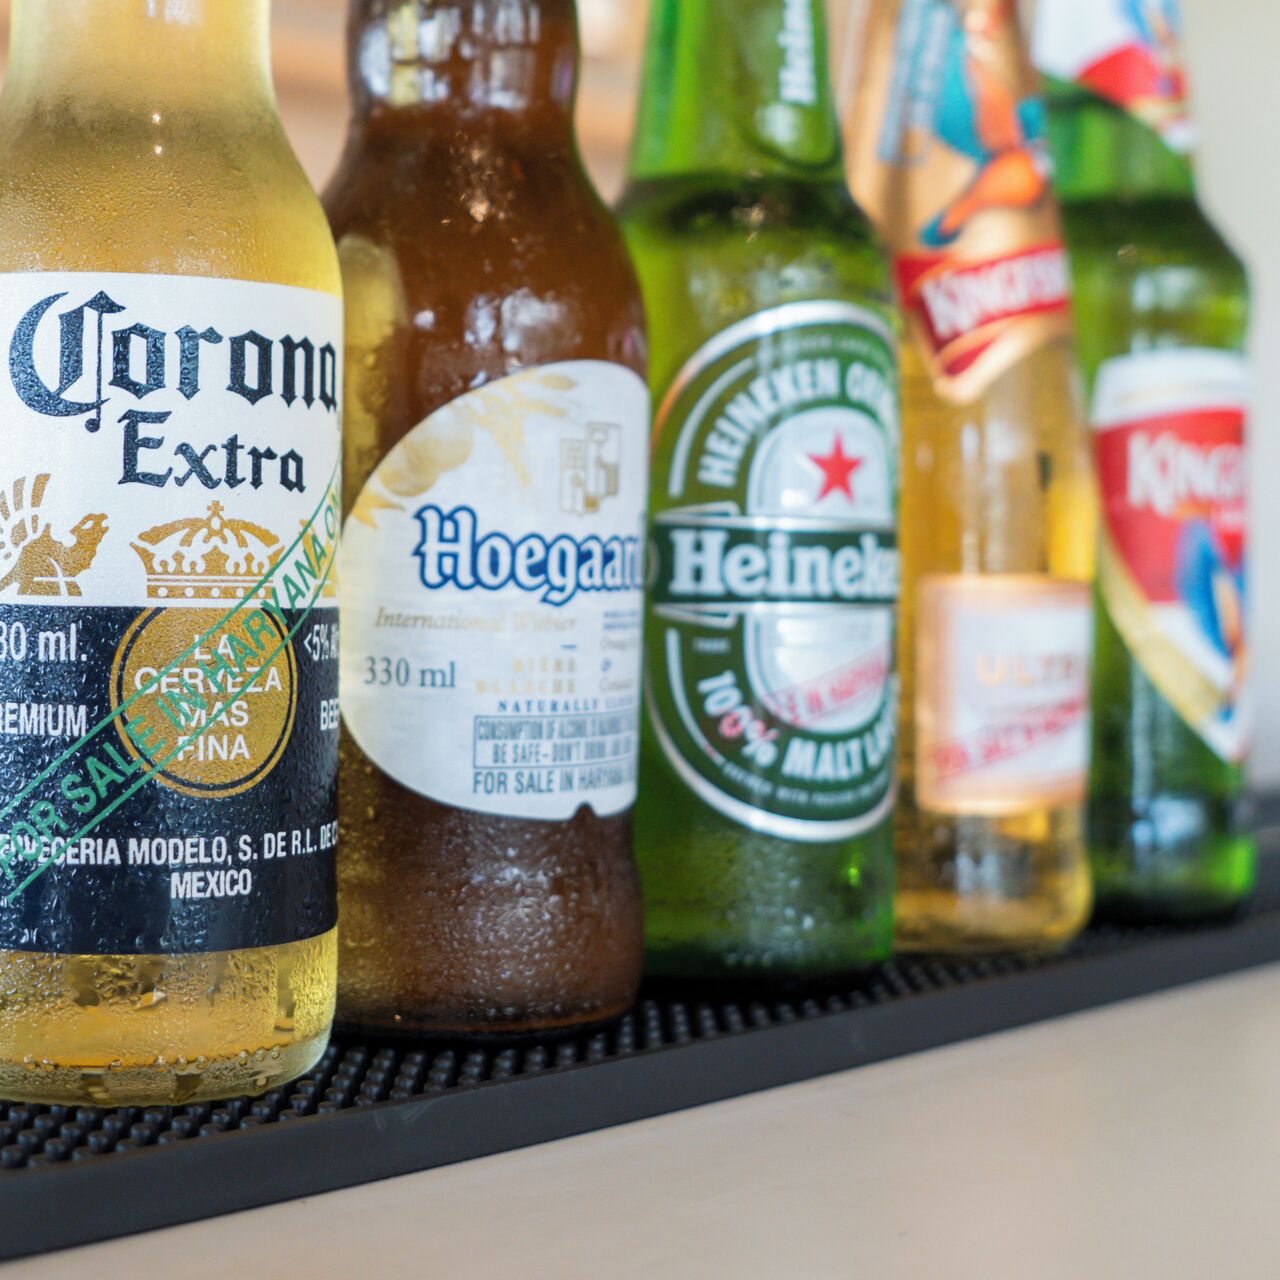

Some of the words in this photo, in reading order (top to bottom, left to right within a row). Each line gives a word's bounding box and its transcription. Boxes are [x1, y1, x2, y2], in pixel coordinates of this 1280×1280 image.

[9, 290, 337, 433] Corona
[697, 356, 840, 488] HEINEKEN
[118, 409, 306, 493] Extra
[39, 623, 87, 662] ml.
[194, 634, 235, 660] LA
[61, 715, 166, 814] SALE
[156, 677, 208, 733] IN
[198, 533, 327, 694] HARYANA
[134, 666, 282, 694] CERVEZA
[364, 656, 410, 687] 330
[419, 661, 456, 688] ml
[179, 700, 249, 727] MAS
[177, 734, 250, 761] FINA
[473, 772, 508, 794] FOR
[514, 770, 554, 794] SALE
[559, 769, 573, 791] IN
[128, 837, 233, 866] MODELO,
[239, 837, 257, 860] S.
[264, 832, 286, 859] DE
[292, 830, 317, 856] R.L.
[170, 869, 251, 899] MEXICO
